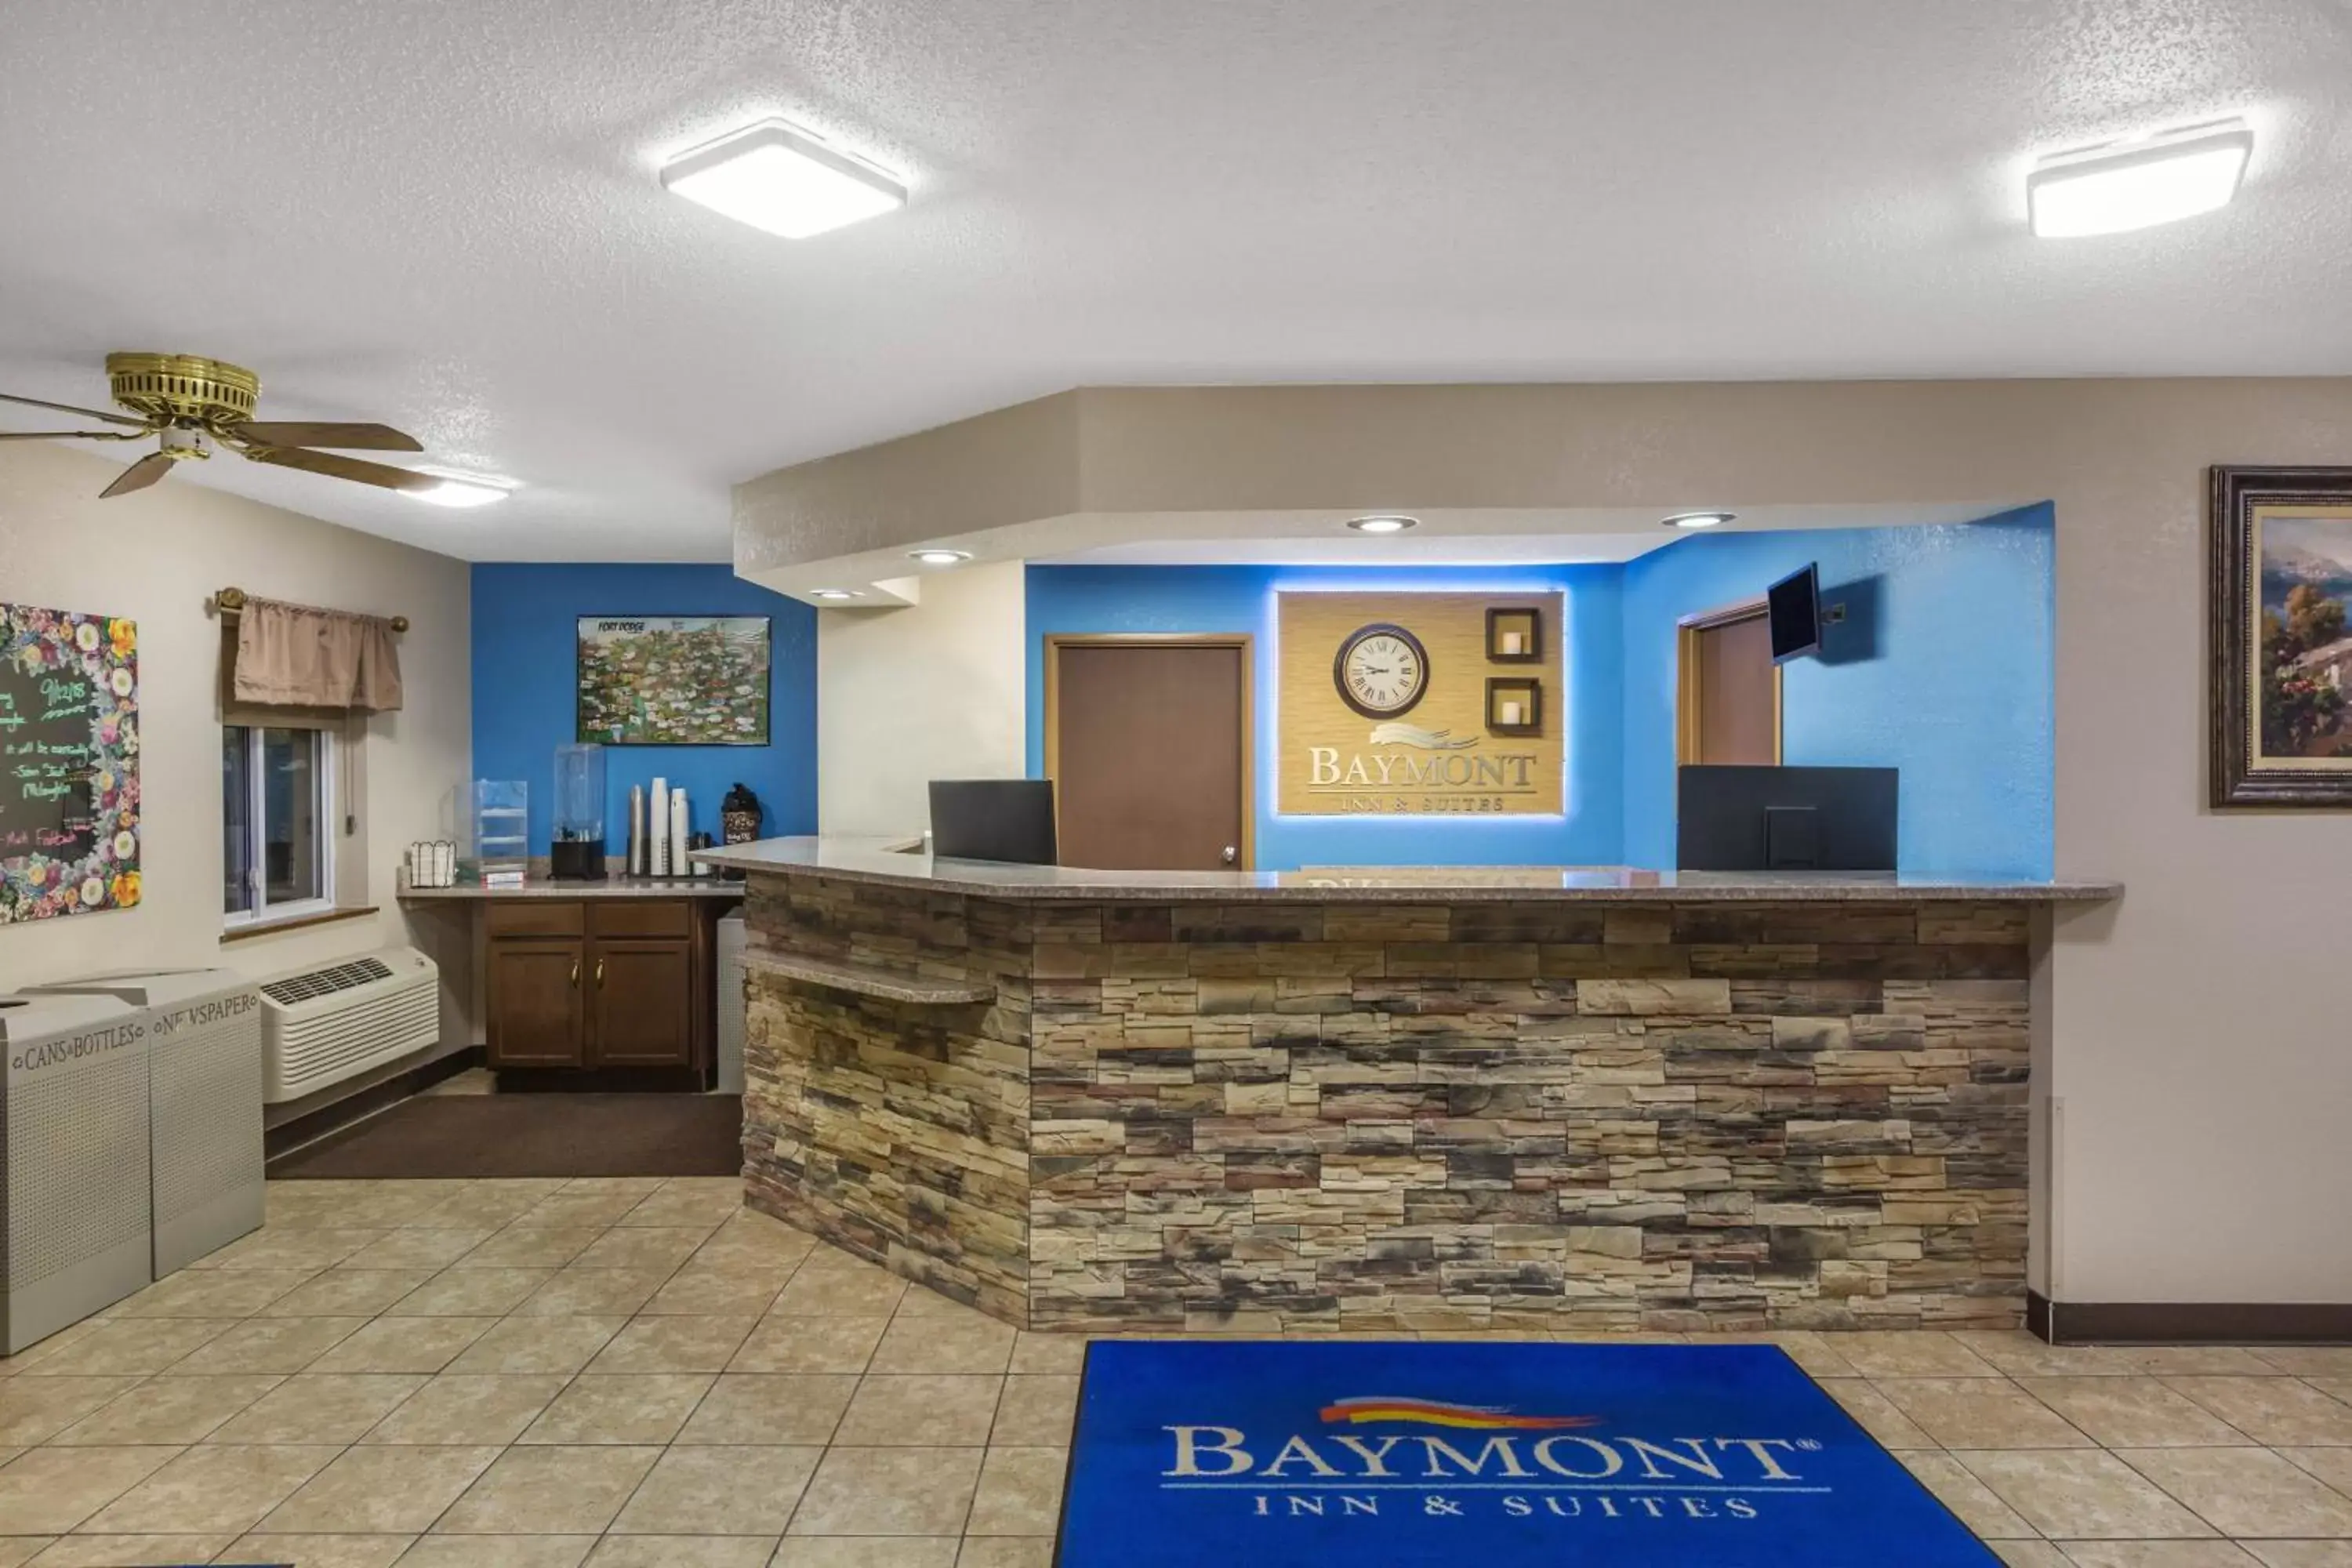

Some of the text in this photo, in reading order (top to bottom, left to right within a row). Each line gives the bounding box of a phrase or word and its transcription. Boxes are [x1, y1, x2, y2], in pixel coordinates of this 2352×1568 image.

[1308, 747, 1537, 787] BAYMONT
[1341, 797, 1504, 812] INN & SUITES
[1161, 1425, 1802, 1479] BAYMONT
[1254, 1494, 1758, 1519] INN & SUITES
